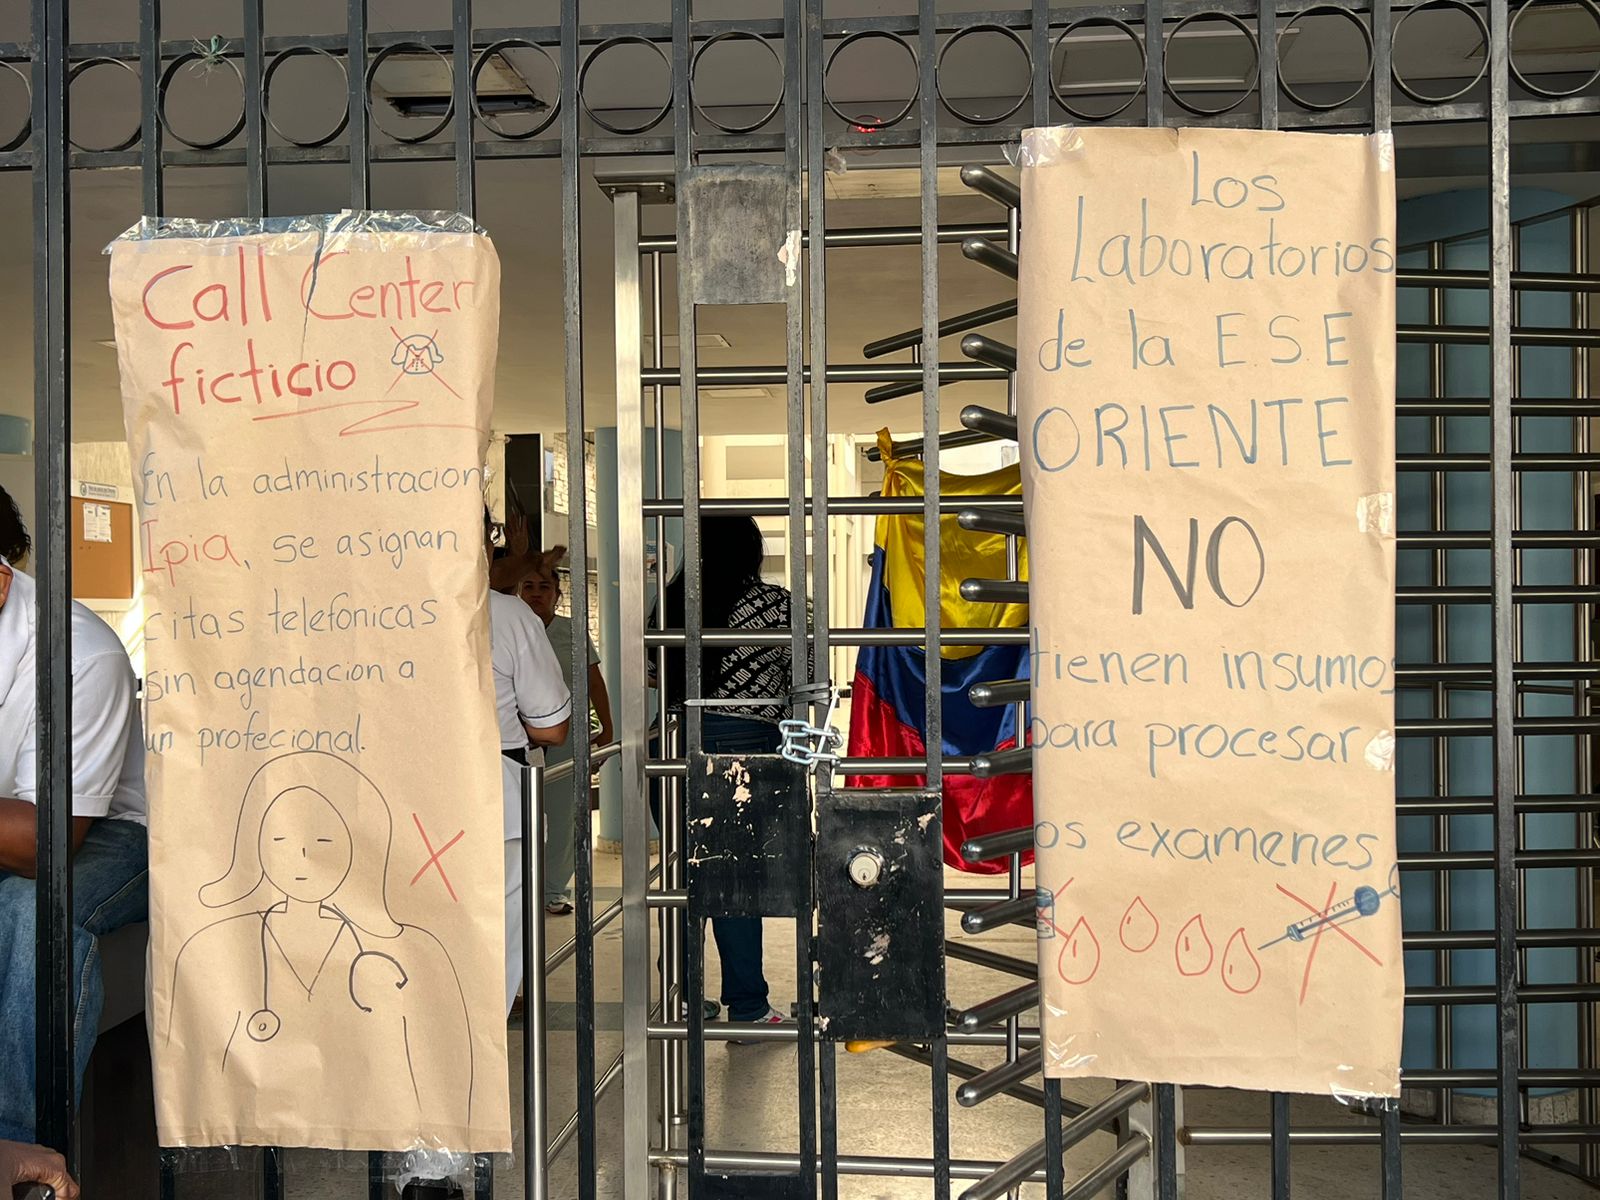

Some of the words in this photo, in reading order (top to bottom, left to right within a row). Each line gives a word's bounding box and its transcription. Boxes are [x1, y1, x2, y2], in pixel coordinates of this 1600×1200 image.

[1191, 150, 1286, 212] Los
[1070, 195, 1395, 286] Laboratorios
[142, 243, 272, 330] Call
[300, 249, 475, 320] Center
[1038, 308, 1092, 372] de
[1129, 308, 1175, 370] la
[162, 338, 356, 415] ficticio
[1032, 396, 1353, 473] ORIENTE
[142, 451, 176, 506] En
[197, 454, 228, 499] la
[252, 454, 483, 495] administracion
[336, 527, 459, 570] asignan
[1132, 514, 1265, 615] NO
[142, 595, 245, 641] citas
[268, 588, 438, 637] telefonicas
[144, 668, 197, 702] sin
[214, 655, 384, 710] agendacion
[398, 659, 416, 680] a
[1030, 626, 1188, 689] tienen
[143, 729, 173, 754] un
[198, 710, 366, 767] profecional.
[1145, 722, 1361, 778] procesar
[1116, 819, 1381, 871] examenes
